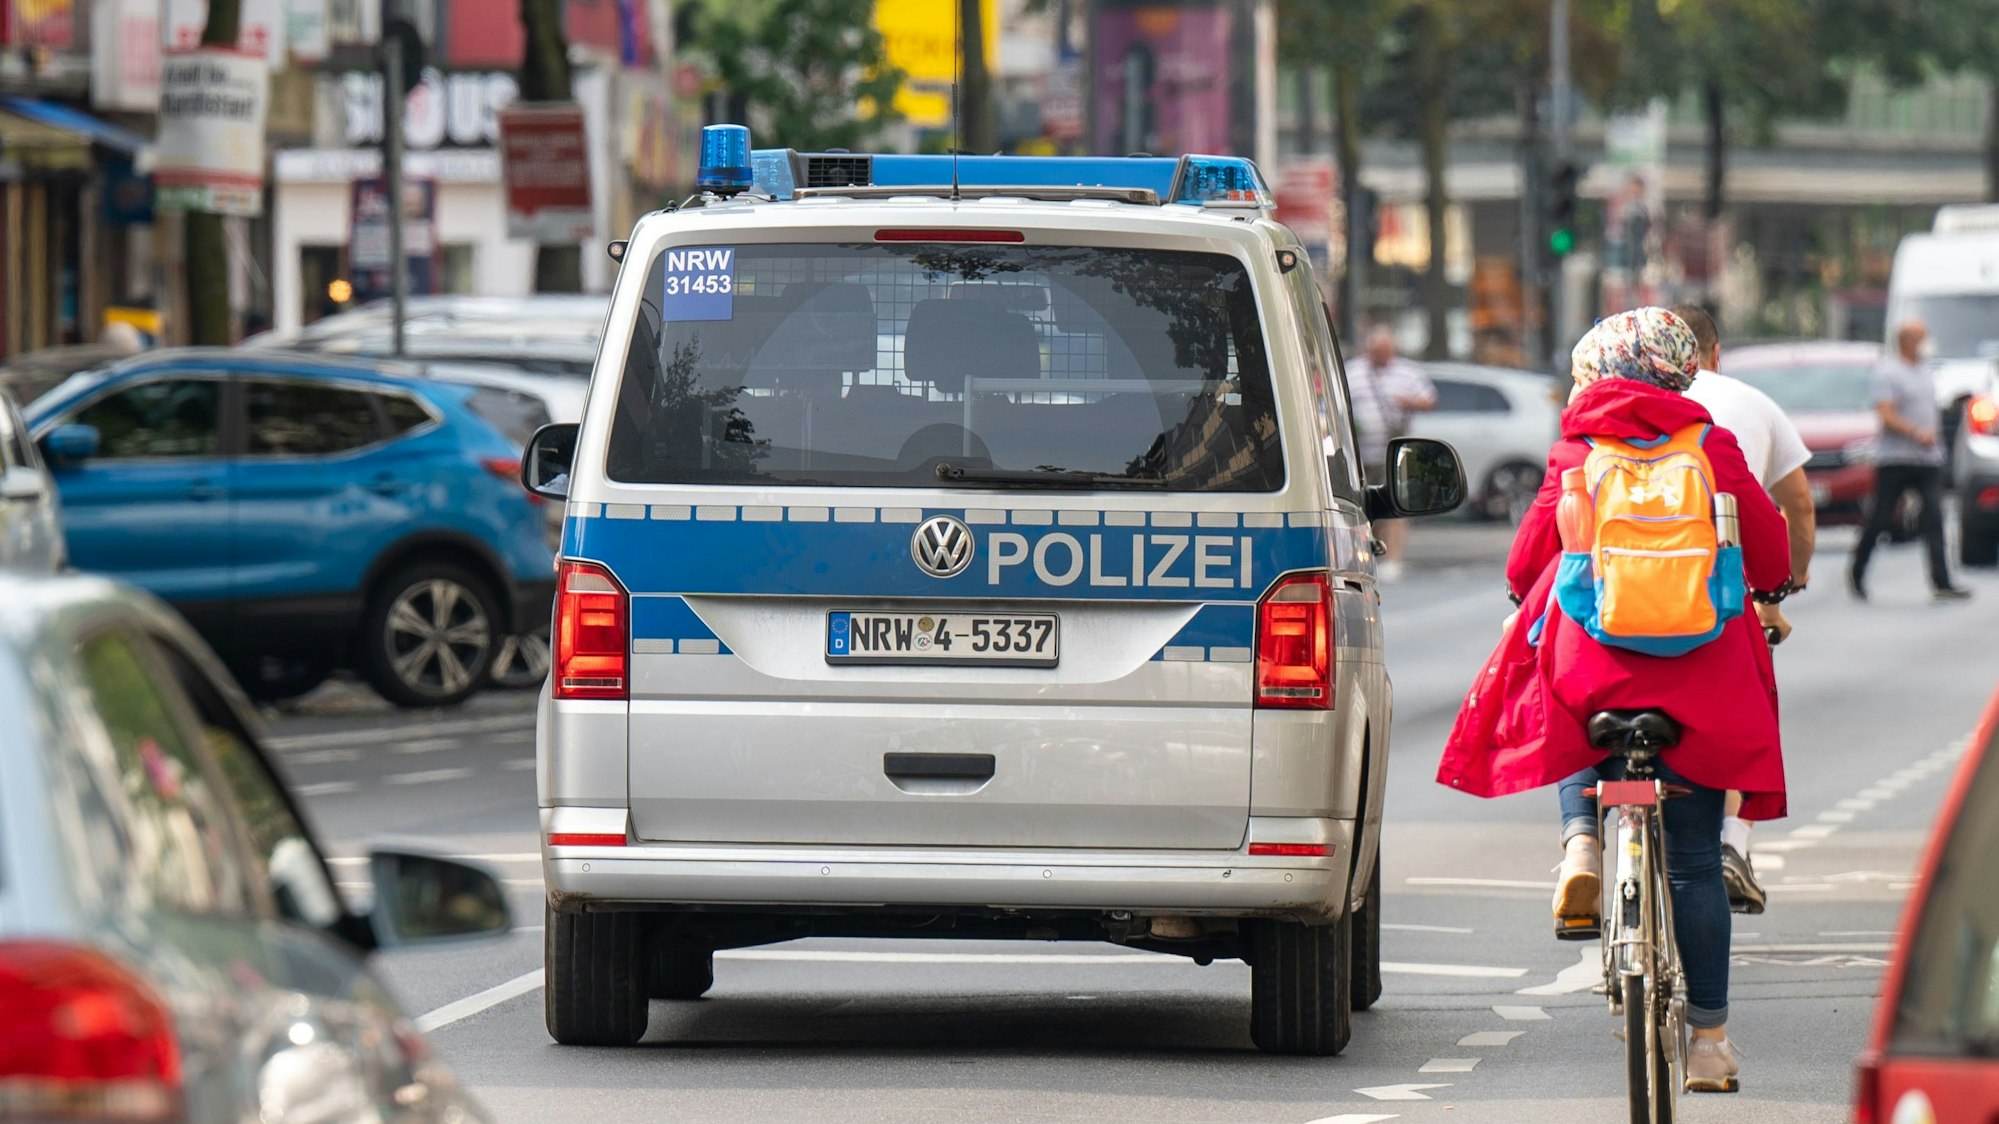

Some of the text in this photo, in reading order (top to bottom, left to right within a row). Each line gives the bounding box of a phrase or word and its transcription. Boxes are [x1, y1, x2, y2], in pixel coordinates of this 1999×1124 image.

[667, 250, 731, 272] NRW
[666, 274, 732, 295] 31453
[915, 518, 971, 575] VW
[988, 532, 1253, 589] POLIZEI
[834, 639, 844, 649] D
[850, 618, 1053, 652] NRW 4-5337
